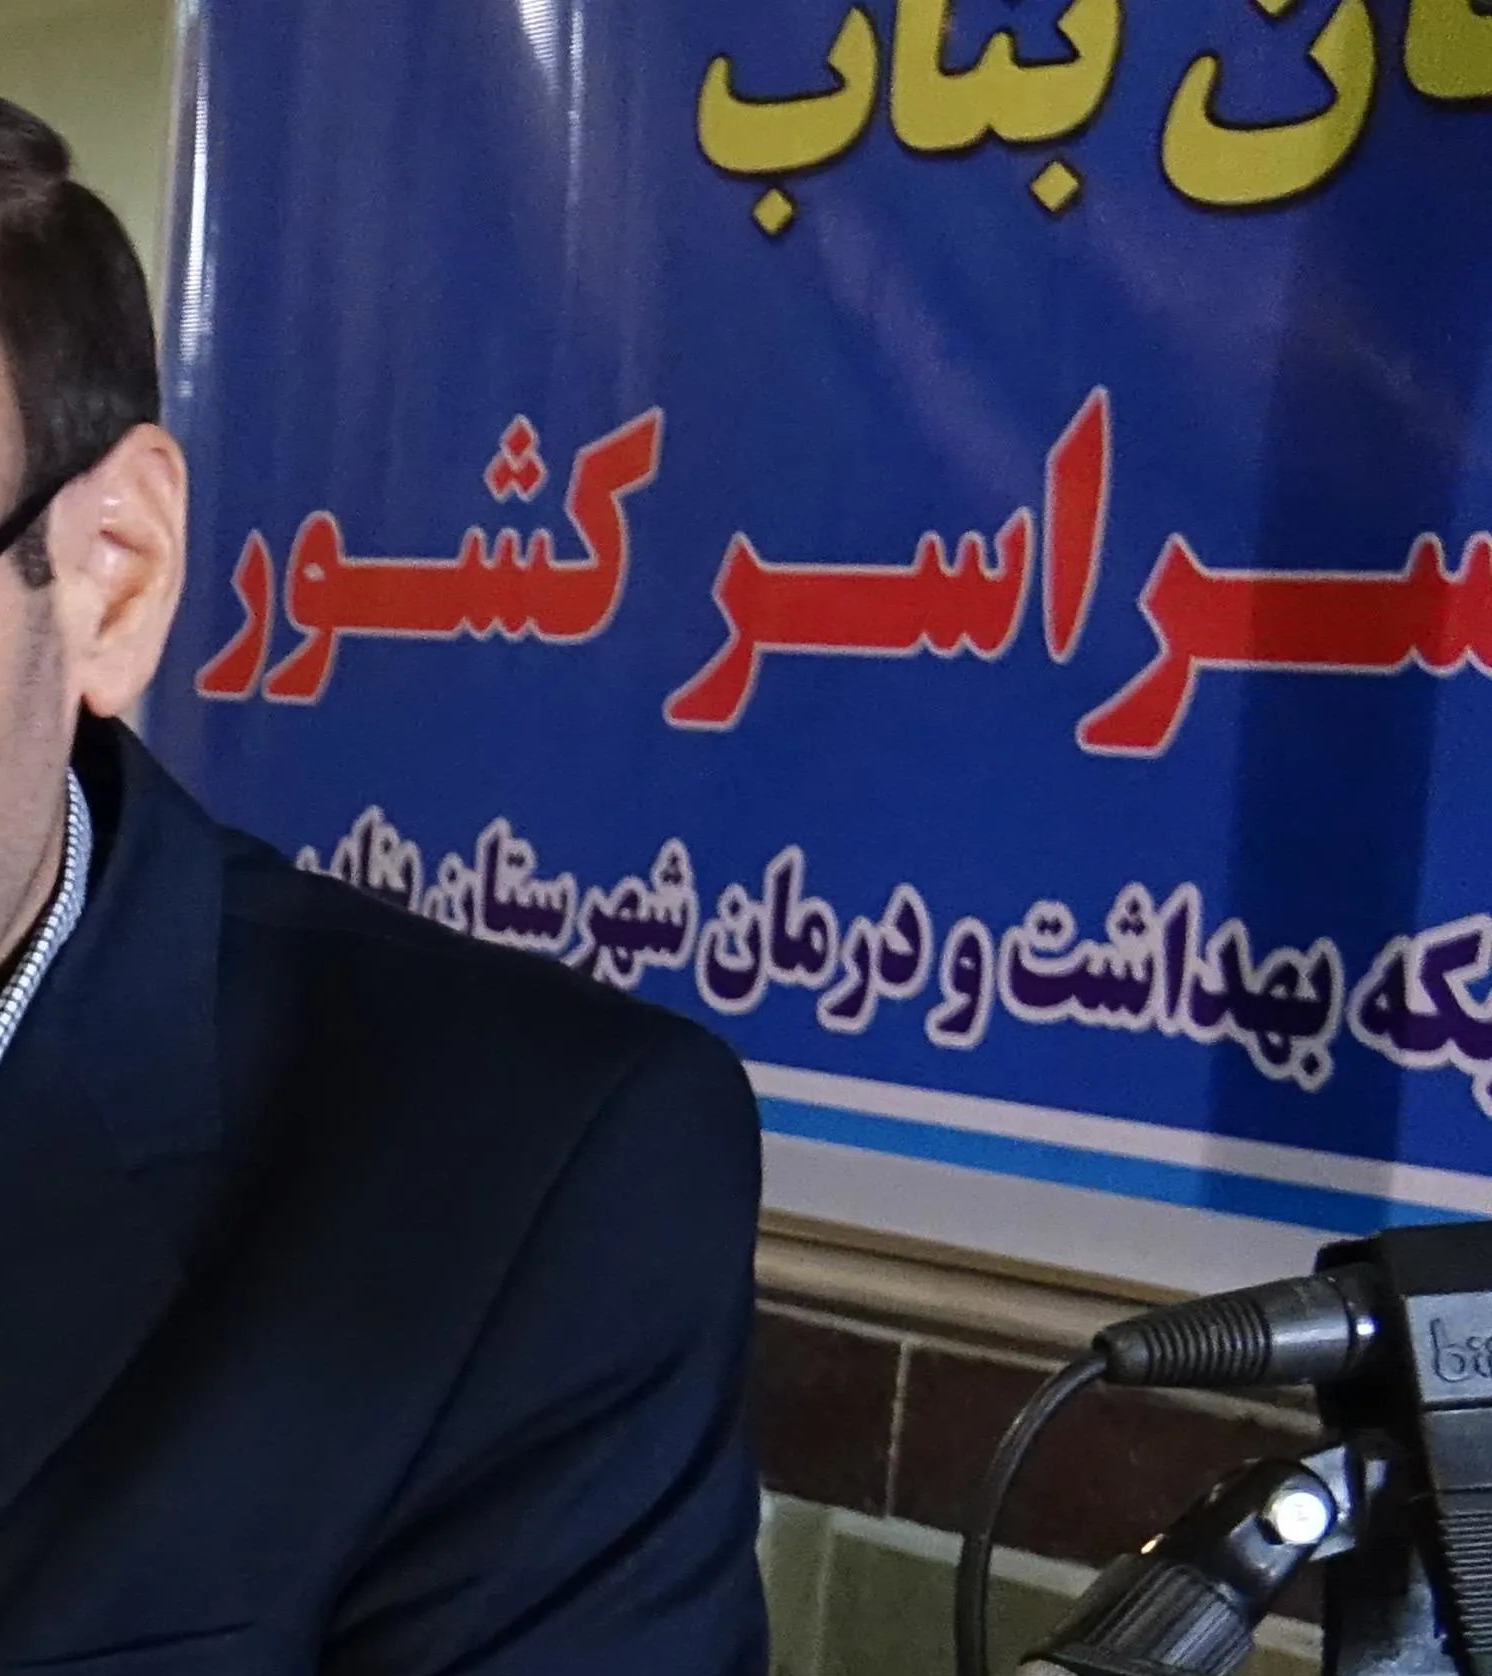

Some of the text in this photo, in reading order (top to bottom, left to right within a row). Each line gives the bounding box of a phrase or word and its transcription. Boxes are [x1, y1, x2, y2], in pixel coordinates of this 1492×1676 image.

[195, 405, 666, 706] کشور
[697, 843, 927, 1035] درمان
[926, 917, 992, 1050] و
[999, 883, 1345, 1092] بهداشت
